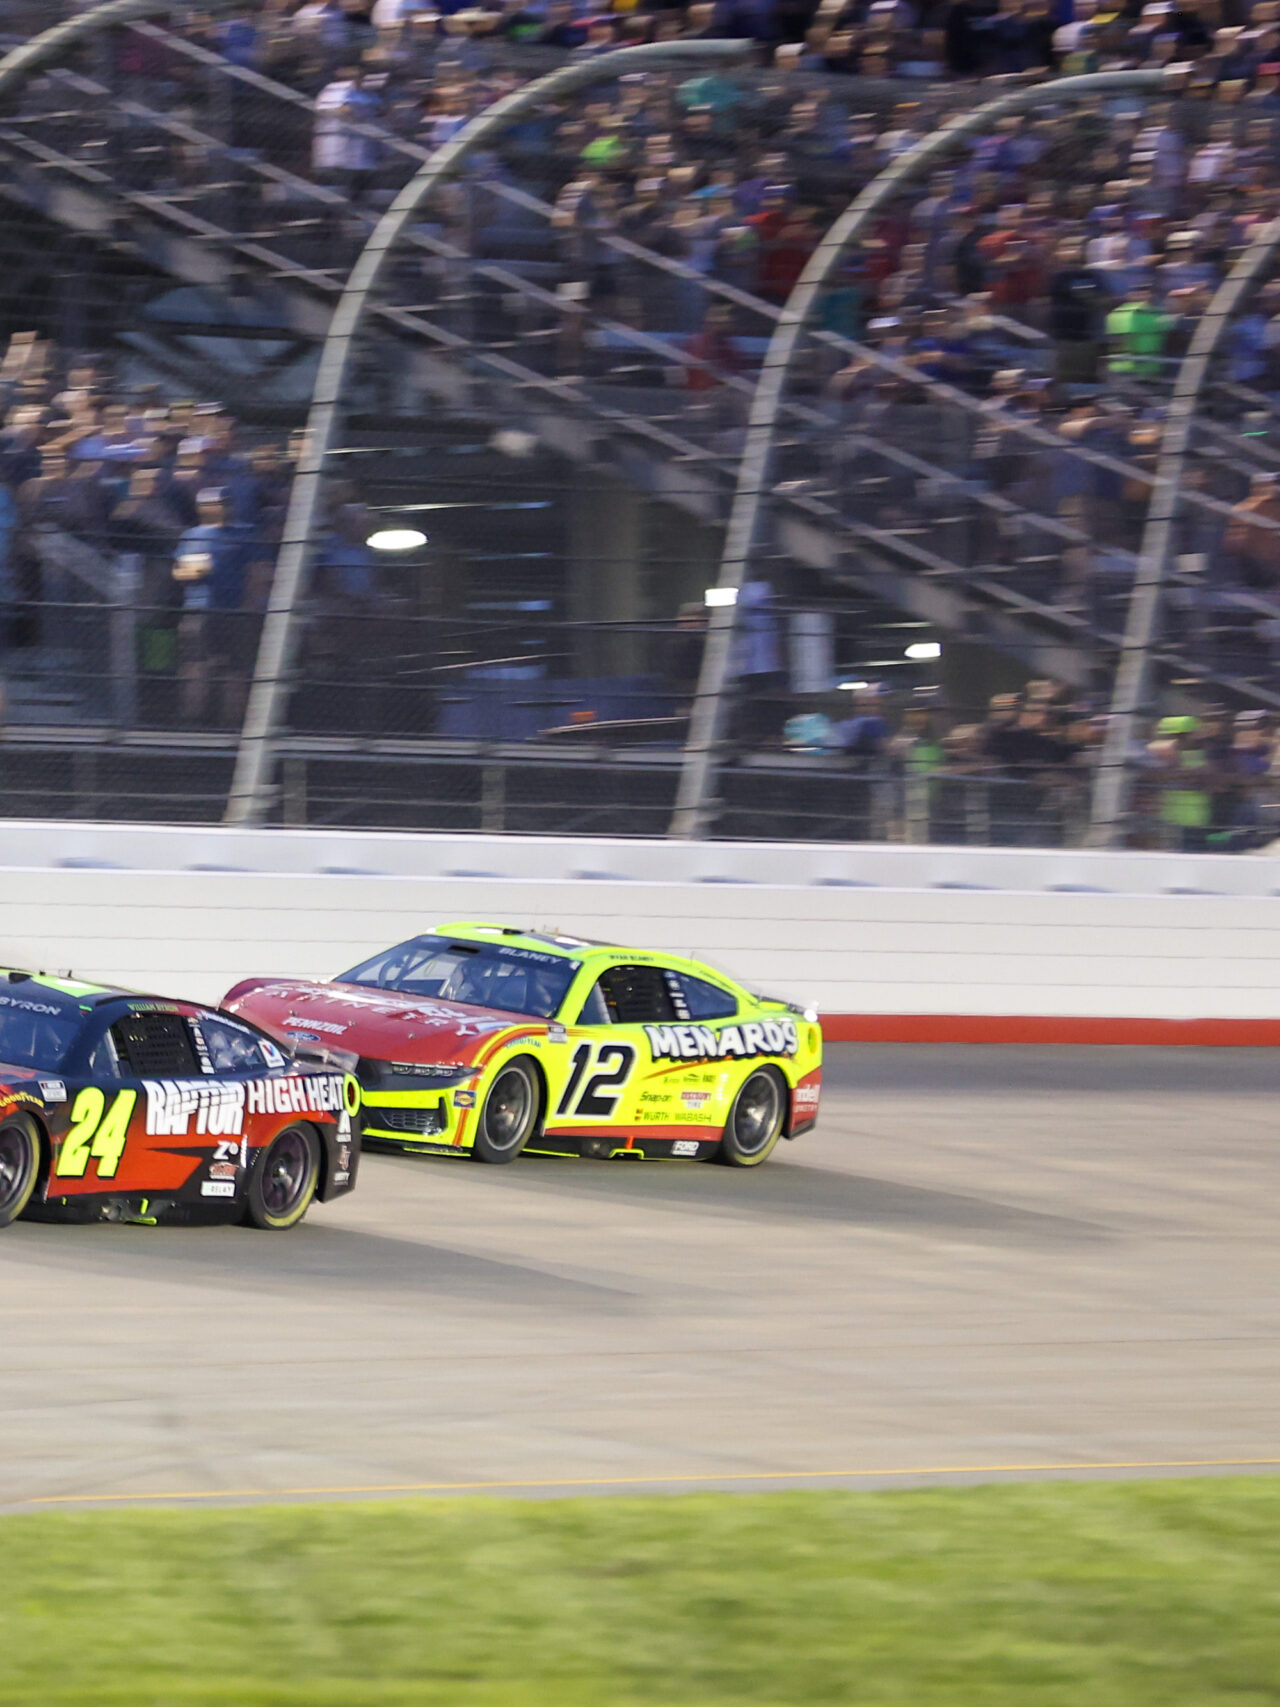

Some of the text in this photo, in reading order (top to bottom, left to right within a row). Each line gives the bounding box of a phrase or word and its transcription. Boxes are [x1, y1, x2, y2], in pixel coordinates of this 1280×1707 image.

[499, 947, 562, 965] BLANEY
[282, 1016, 348, 1035] PENNZOIL
[644, 1022, 798, 1062] MENARDS
[555, 1041, 636, 1118] 12
[141, 1075, 345, 1136] RAPTOR HIGH HEAT
[56, 1087, 137, 1178] 24
